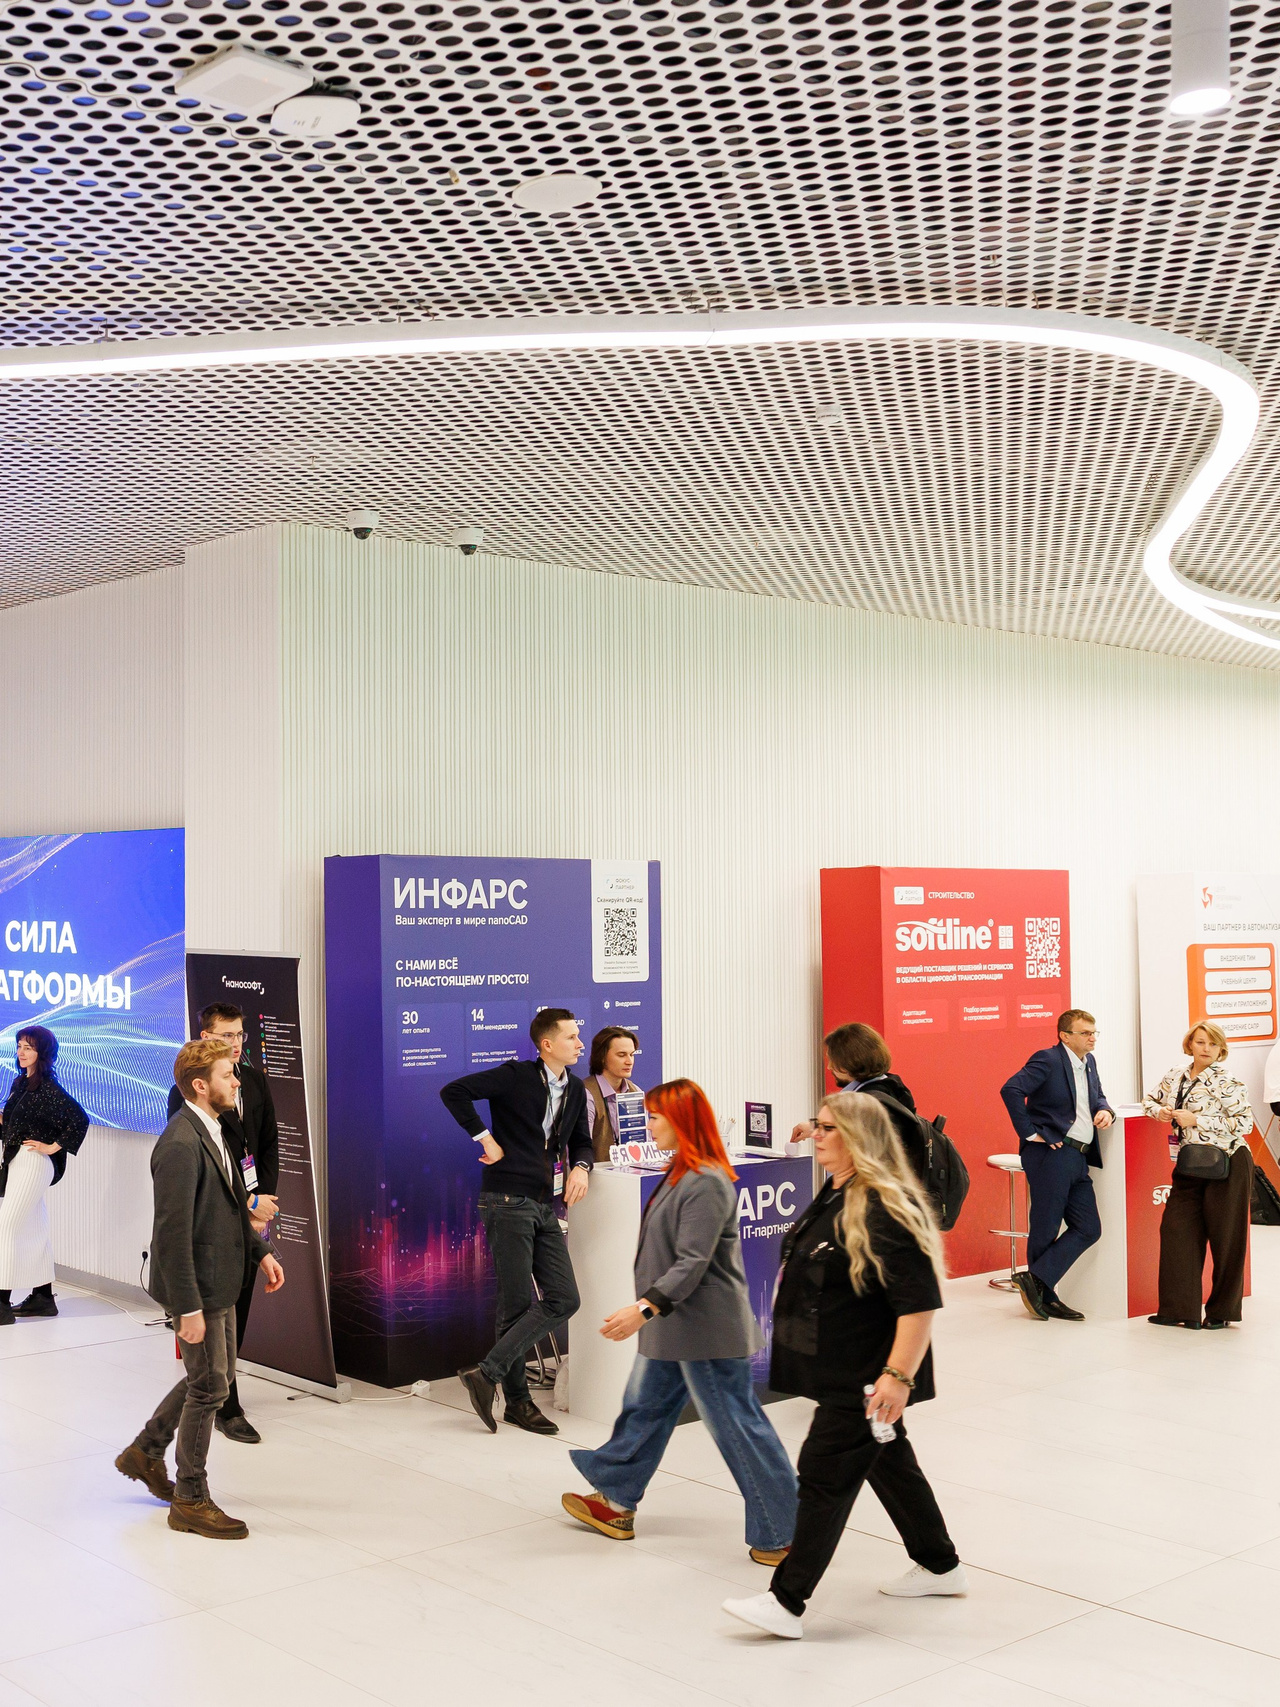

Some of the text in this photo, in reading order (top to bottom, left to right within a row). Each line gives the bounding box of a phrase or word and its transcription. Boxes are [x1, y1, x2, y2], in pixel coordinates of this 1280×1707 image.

[394, 877, 528, 910] ИНФАРС
[927, 891, 976, 900] СТРОИТЕЛЬСТВО
[395, 914, 528, 927] Ваш эксперт в мире nanoCAD
[1203, 923, 1216, 931] ВАШ
[1217, 923, 1242, 931] ПАРТНЕР
[1243, 923, 1247, 931] В
[5, 920, 77, 954] СИЛА
[395, 957, 459, 971] С НАМИ ВСЁ
[896, 962, 1014, 974] ВЕДУЩИЙ ПОСТАВЩИК РЕШЕНИЙ И СЕРВИСОВ
[224, 980, 262, 991] нанософт
[396, 974, 530, 988] ПО-НАСТОЯЩЕМУ ПРОСТО!
[896, 976, 901, 984] В
[927, 974, 957, 983] ЦИФРОВОЙ
[958, 973, 1004, 982] ТРАНСФОРМАЦИИ
[402, 1010, 419, 1025] 30
[470, 1008, 485, 1022] 14
[736, 1181, 796, 1223] АРС
[1152, 1185, 1172, 1205] so
